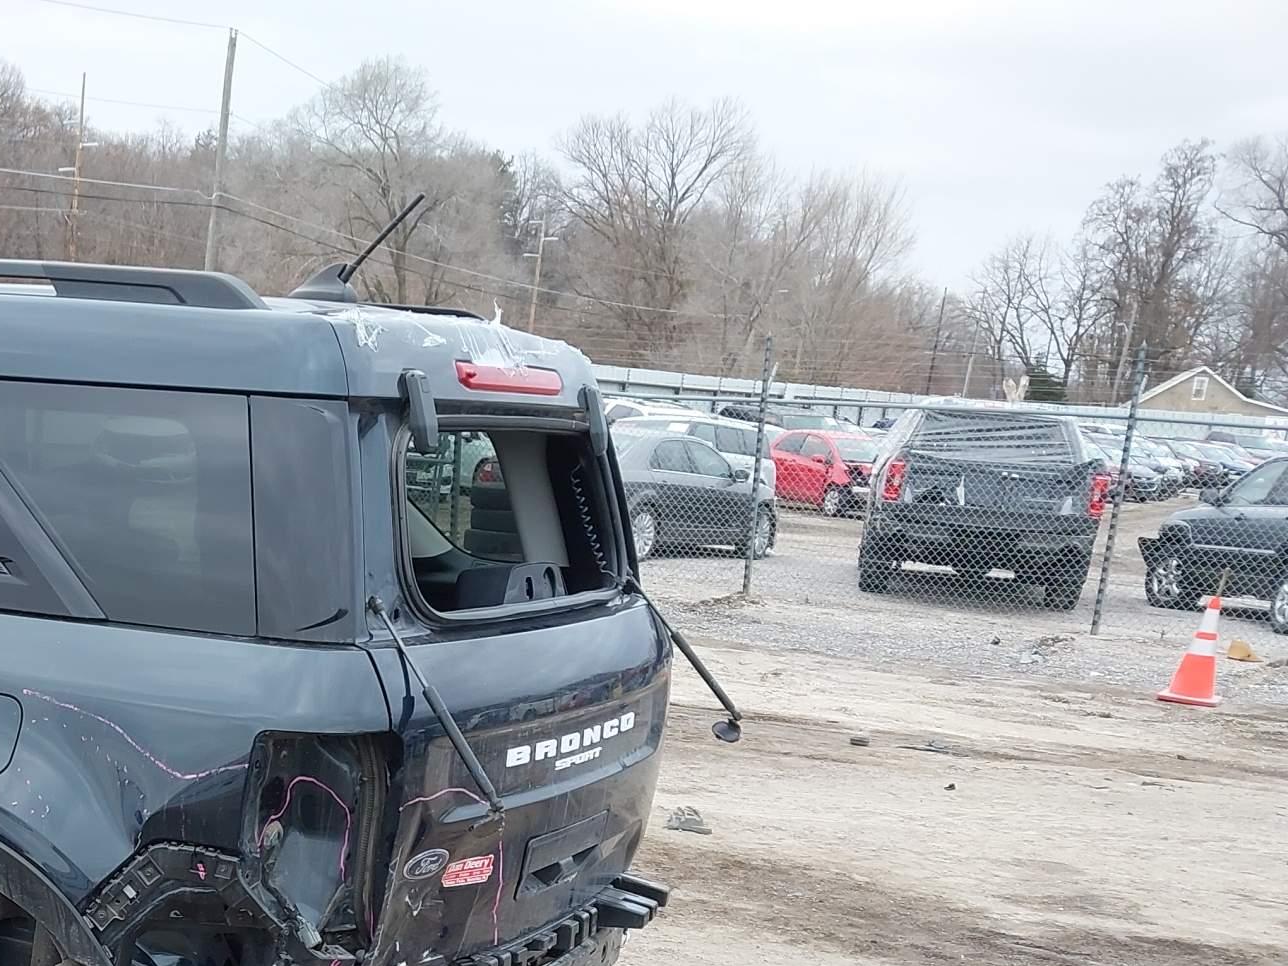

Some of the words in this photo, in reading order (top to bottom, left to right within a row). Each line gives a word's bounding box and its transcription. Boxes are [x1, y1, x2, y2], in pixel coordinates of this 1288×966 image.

[505, 711, 636, 768] BRONCO
[554, 746, 603, 771] SPORT
[414, 856, 443, 875] Ford
